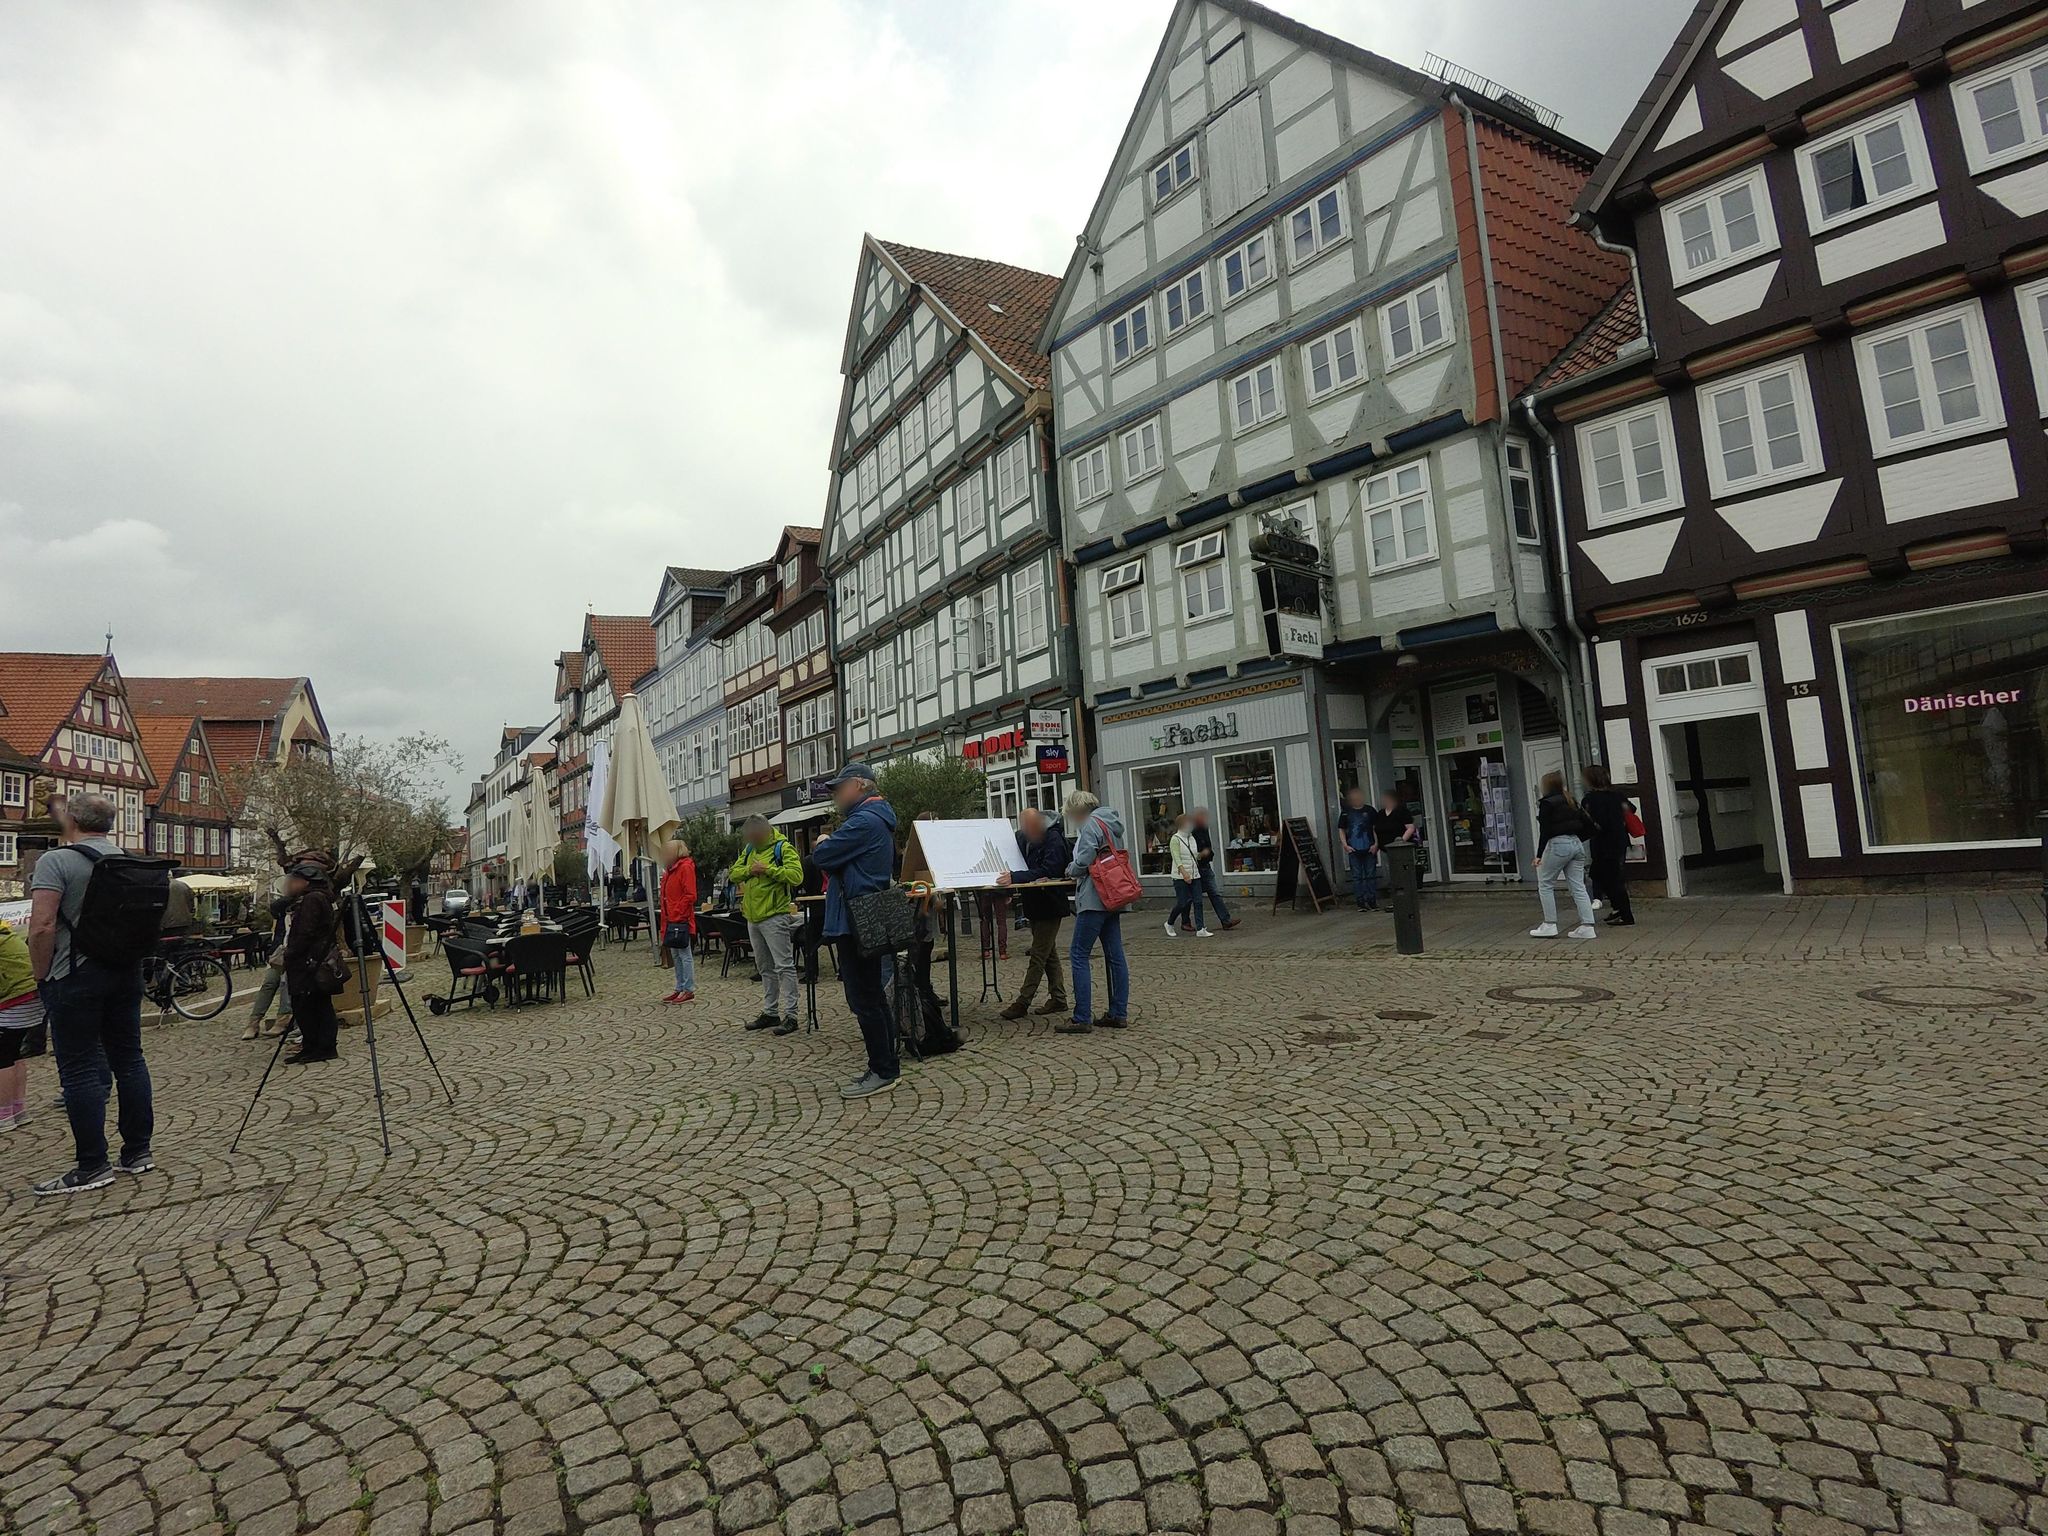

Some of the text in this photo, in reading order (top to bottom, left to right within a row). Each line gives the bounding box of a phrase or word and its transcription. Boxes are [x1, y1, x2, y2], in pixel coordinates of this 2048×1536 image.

[1675, 611, 1708, 626] 1675
[1290, 627, 1319, 645] Fachl
[1791, 683, 1810, 696] 13
[1904, 688, 2020, 713] Dänischer
[1162, 711, 1239, 749] Fachl
[1045, 747, 1059, 758] sky
